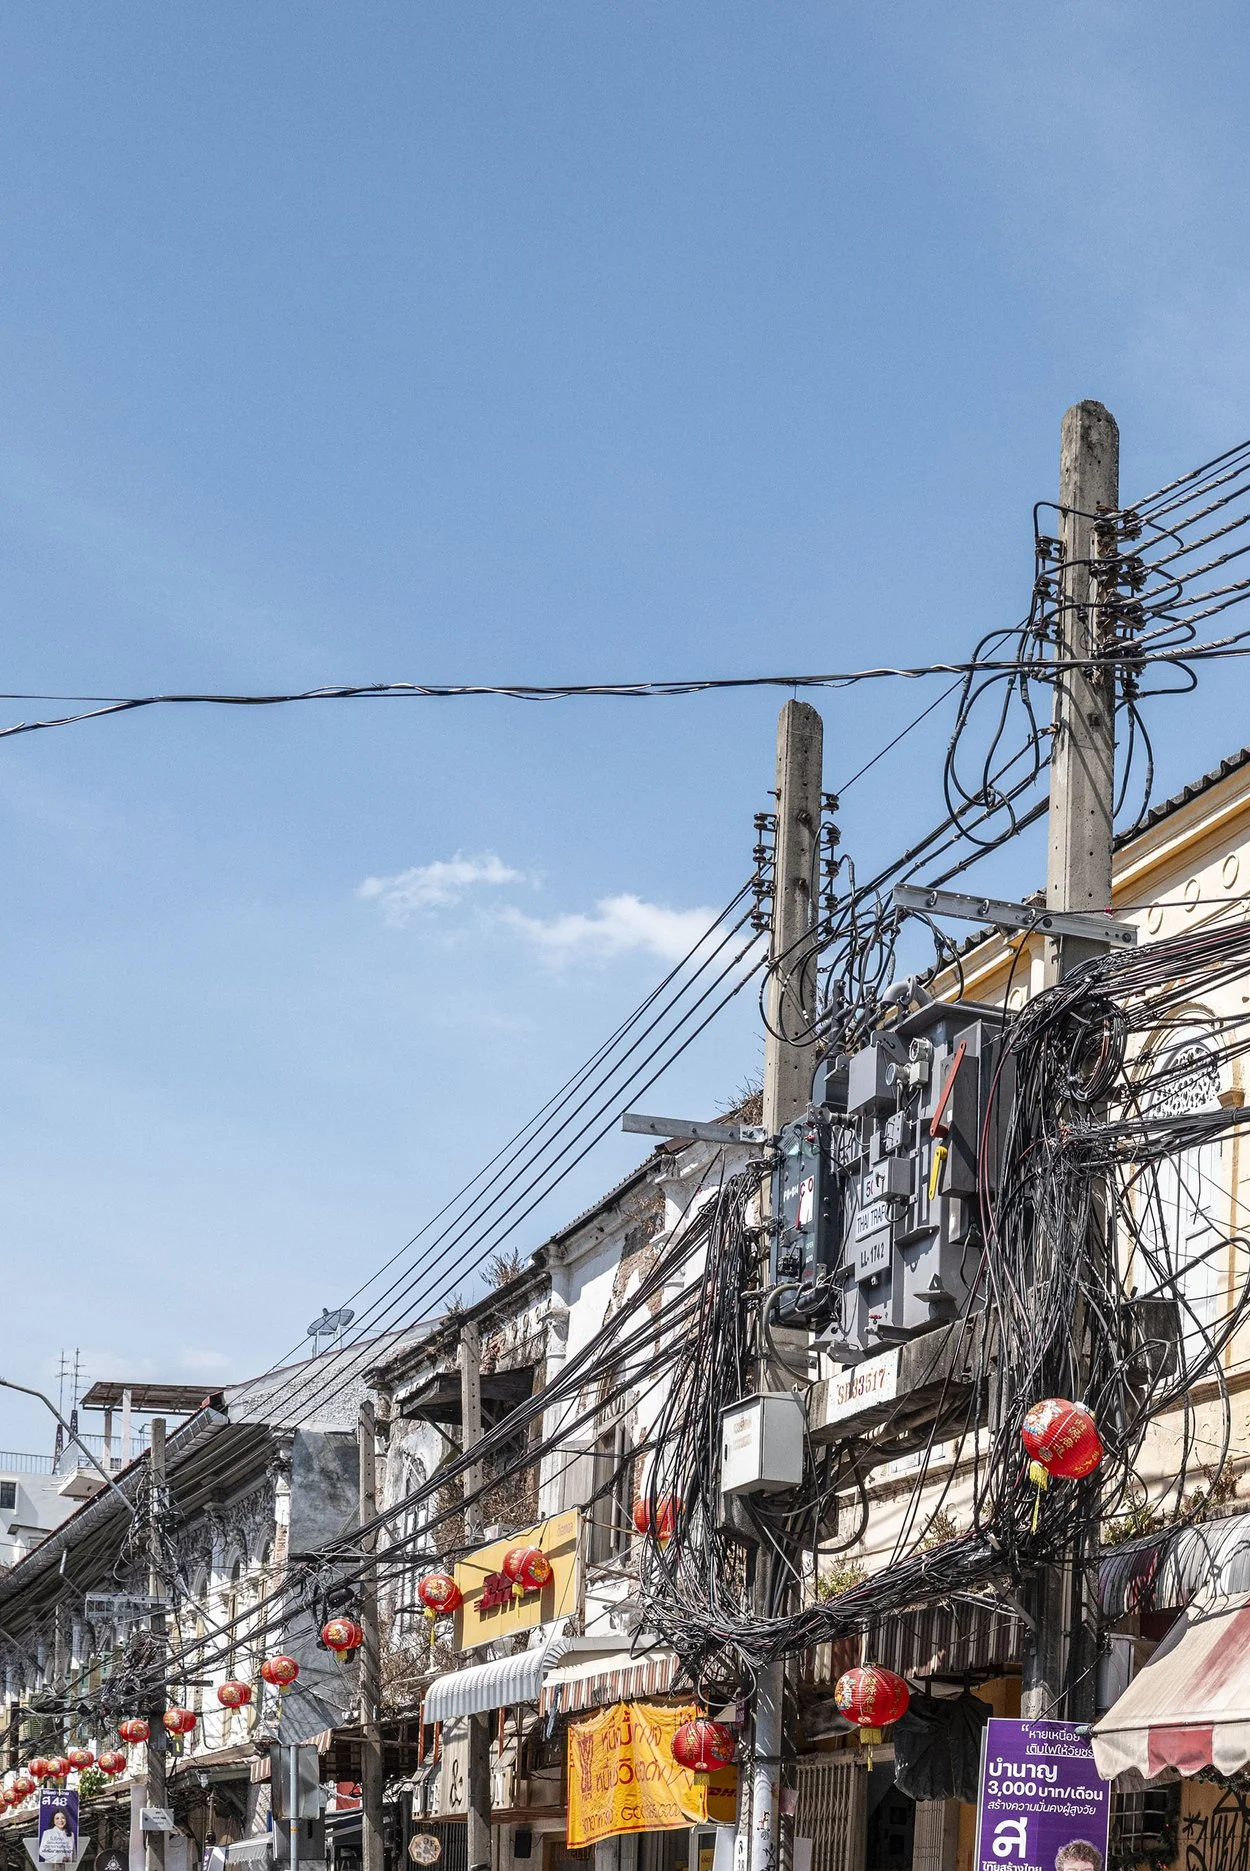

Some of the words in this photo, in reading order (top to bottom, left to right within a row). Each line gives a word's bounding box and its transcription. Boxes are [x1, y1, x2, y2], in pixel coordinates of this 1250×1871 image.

[1026, 1743, 1095, 1758] เติมไฟให้วัยชร
[989, 1757, 1058, 1782] บำนาญ
[708, 1787, 737, 1798] DH
[987, 1780, 1037, 1797] 3,000
[1038, 1786, 1103, 1801] บาท/เดือน
[52, 1796, 68, 1807] 48
